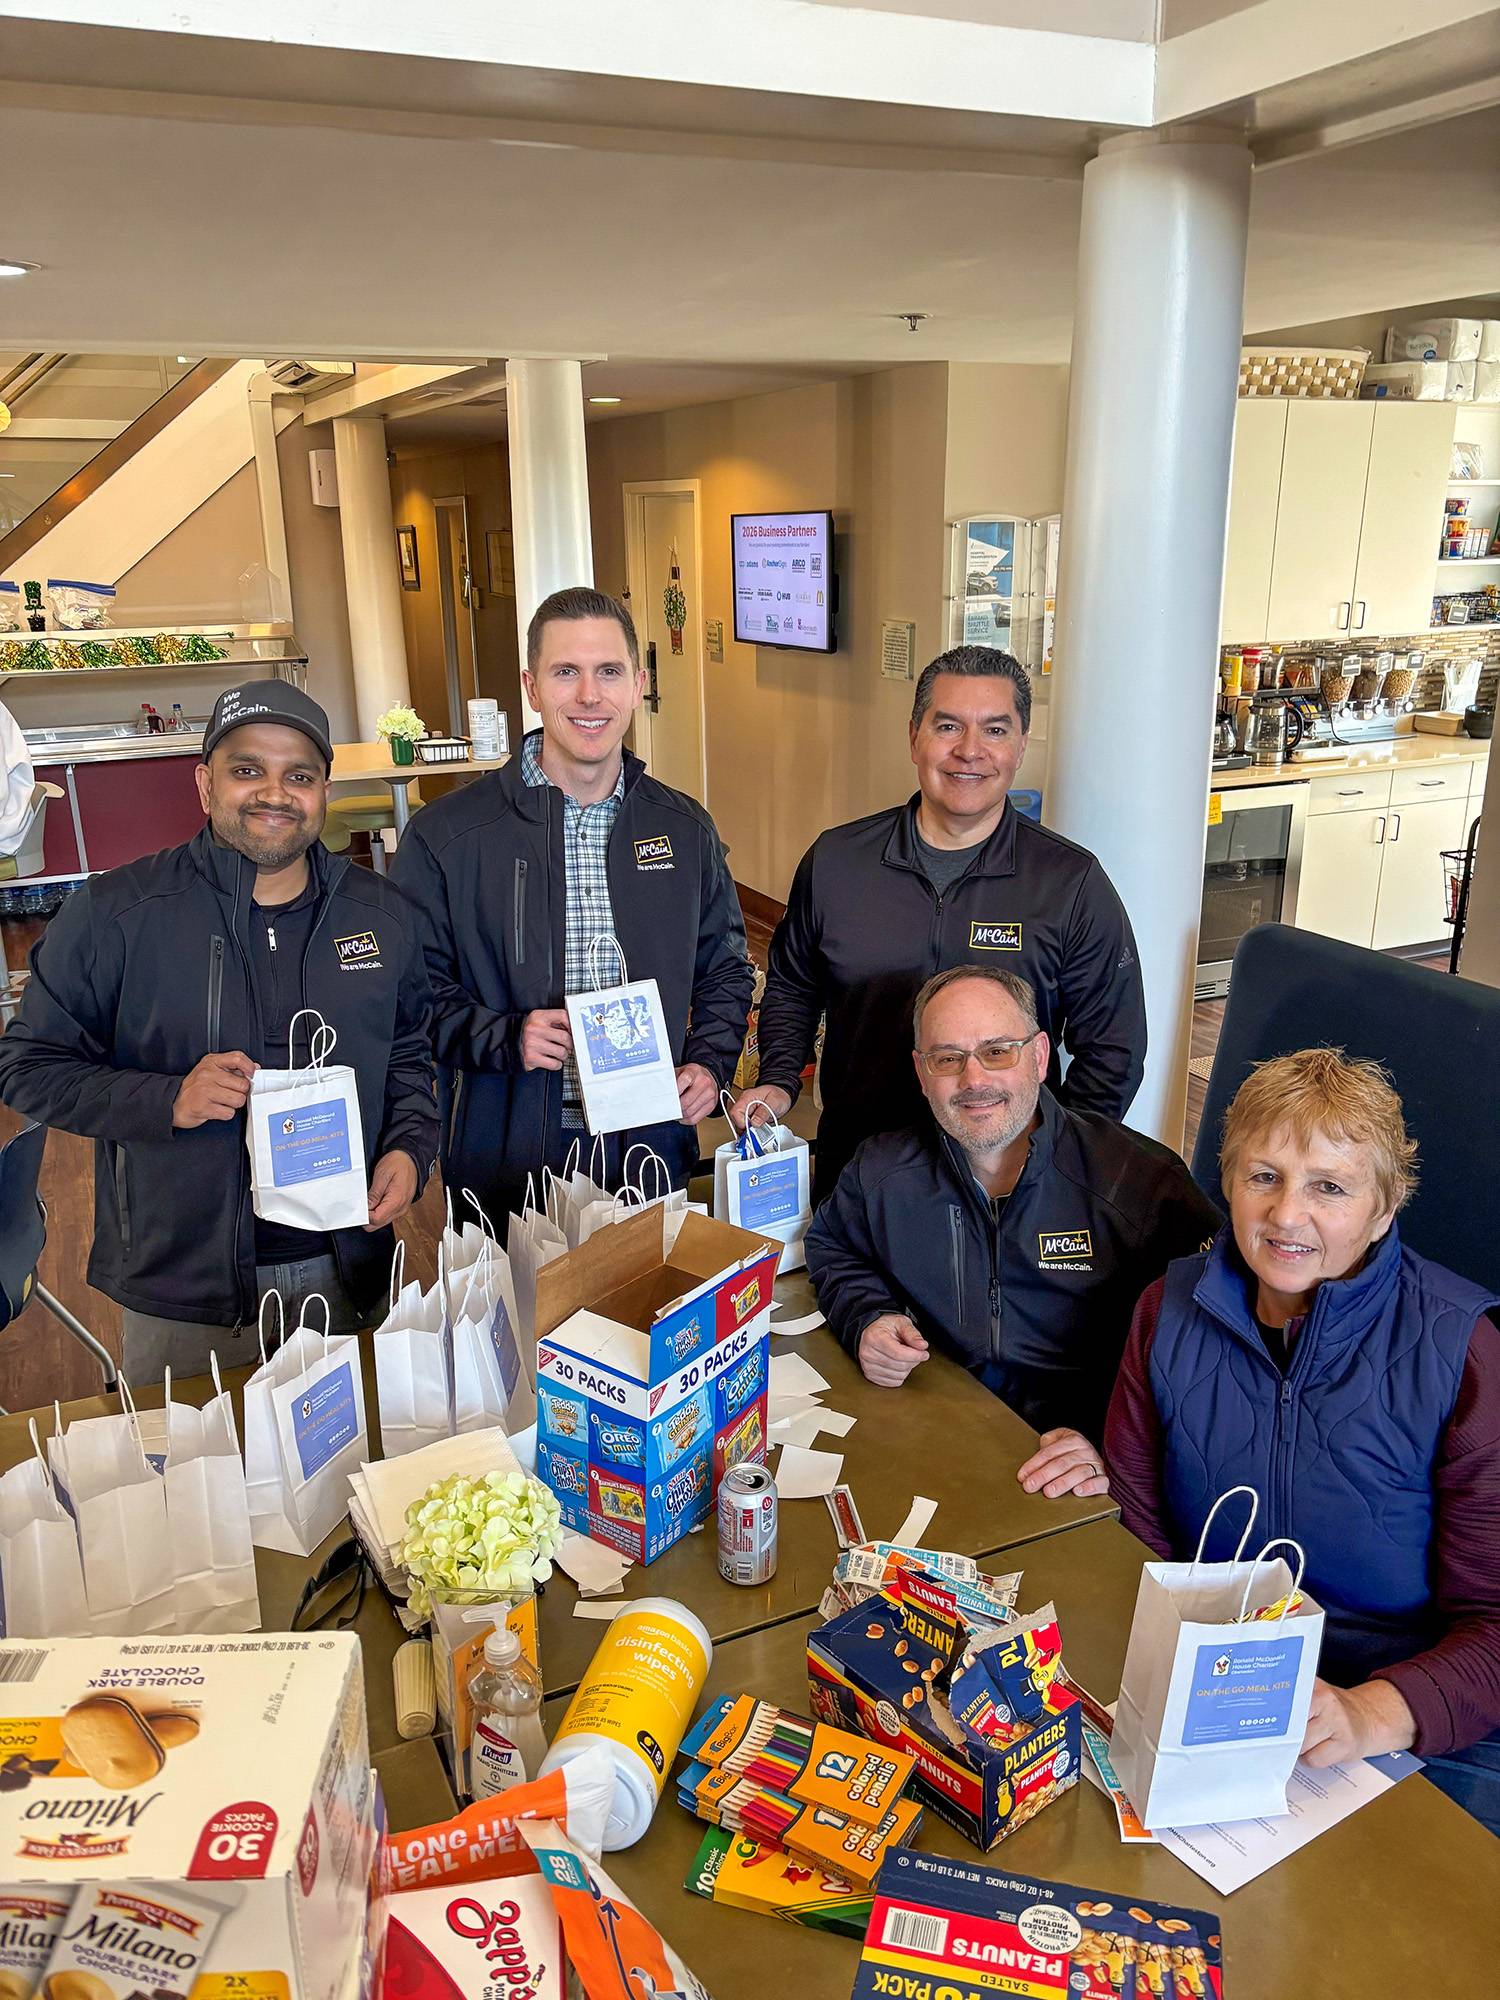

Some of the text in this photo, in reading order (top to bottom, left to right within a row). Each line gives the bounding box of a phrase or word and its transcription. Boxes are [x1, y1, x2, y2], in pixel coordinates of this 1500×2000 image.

[742, 524, 816, 537] 2026 Business Partners
[792, 559, 806, 567] ARCO
[224, 691, 240, 704] We
[221, 704, 272, 726] McCain.
[222, 701, 240, 716] are
[638, 843, 671, 858] McCain
[972, 928, 1020, 946] McCain
[340, 940, 378, 957] McCain
[1044, 1238, 1090, 1254] McCain
[1038, 1261, 1049, 1269] We
[1063, 1263, 1093, 1271] McCain.
[680, 1330, 748, 1394] 30 PACKS
[555, 1360, 626, 1404] 30 PACKS
[551, 1398, 576, 1413] Teddy
[669, 1400, 697, 1430] Teddy
[601, 1431, 640, 1444] OREO
[654, 1424, 660, 1434] 7
[613, 1444, 636, 1453] mini
[666, 1478, 690, 1511] Chips
[908, 1581, 960, 1615] PEANUTS
[956, 1594, 988, 1613] RIGINAL
[900, 1602, 955, 1656] ANTERS
[220, 1642, 239, 1653] PACKS
[239, 1642, 261, 1652] COOKIE
[616, 1636, 695, 1689] disinfecting
[633, 1652, 677, 1681] wipes
[1255, 1653, 1286, 1663] McDonald
[101, 1666, 200, 1678] CHOCOLATE
[85, 1676, 205, 1688] DOUBLE DARK
[1213, 1687, 1230, 1696] THE
[1231, 1686, 1245, 1694] GO
[1246, 1684, 1270, 1692] MEAL
[1272, 1681, 1291, 1689] KITS
[960, 1688, 990, 1722] PLANTERS
[976, 1708, 995, 1730] PEANUTS
[0, 1736, 37, 1745] CHO
[716, 1724, 738, 1748] BigBox
[483, 1746, 510, 1764] Purell
[921, 1741, 944, 1761] SALTED
[491, 1764, 518, 1778] SANITIZER
[817, 1753, 856, 1782] 12
[905, 1744, 962, 1794] PEANUTS
[1021, 1760, 1053, 1789] PEANUTS
[716, 1772, 732, 1784] Big
[848, 1754, 881, 1800] colored
[864, 1762, 897, 1807] pencils
[25, 1792, 164, 1828] Milano
[225, 1813, 266, 1823] PACKS
[211, 1822, 274, 1832] 2-COOKIE
[814, 1808, 848, 1830] 1
[208, 1834, 266, 1862] 30
[392, 1829, 467, 1868] LONG
[469, 1833, 530, 1864] ME
[703, 1848, 720, 1872] Classic
[915, 1859, 937, 1872] (1.3kg)
[549, 1855, 570, 1883] 28
[937, 1866, 947, 1875] LB
[953, 1870, 966, 1880] WT
[966, 1873, 980, 1882] NET
[696, 1873, 716, 1893] 10
[985, 1876, 1008, 1889] PACKS
[1009, 1881, 1027, 1893] (28g)
[1027, 1885, 1038, 1895] OZ
[1039, 1888, 1055, 1899] 48-1
[1022, 1922, 1079, 1938] PLANT-BASED
[1033, 1918, 1069, 1930] PROTEIN
[63, 1914, 198, 1970] Milano
[1027, 1934, 1060, 1951] PROTEIN
[72, 1944, 134, 1968] DOUBLE
[138, 1962, 180, 1982] DARK
[952, 1937, 1063, 1978] PEANUTS
[76, 1957, 167, 1987] CHOCOLATE
[224, 1976, 249, 1987] 2X
[873, 1971, 932, 2000] PACK
[980, 1974, 1029, 1993] SALTED
[495, 1983, 506, 2000] POTA
